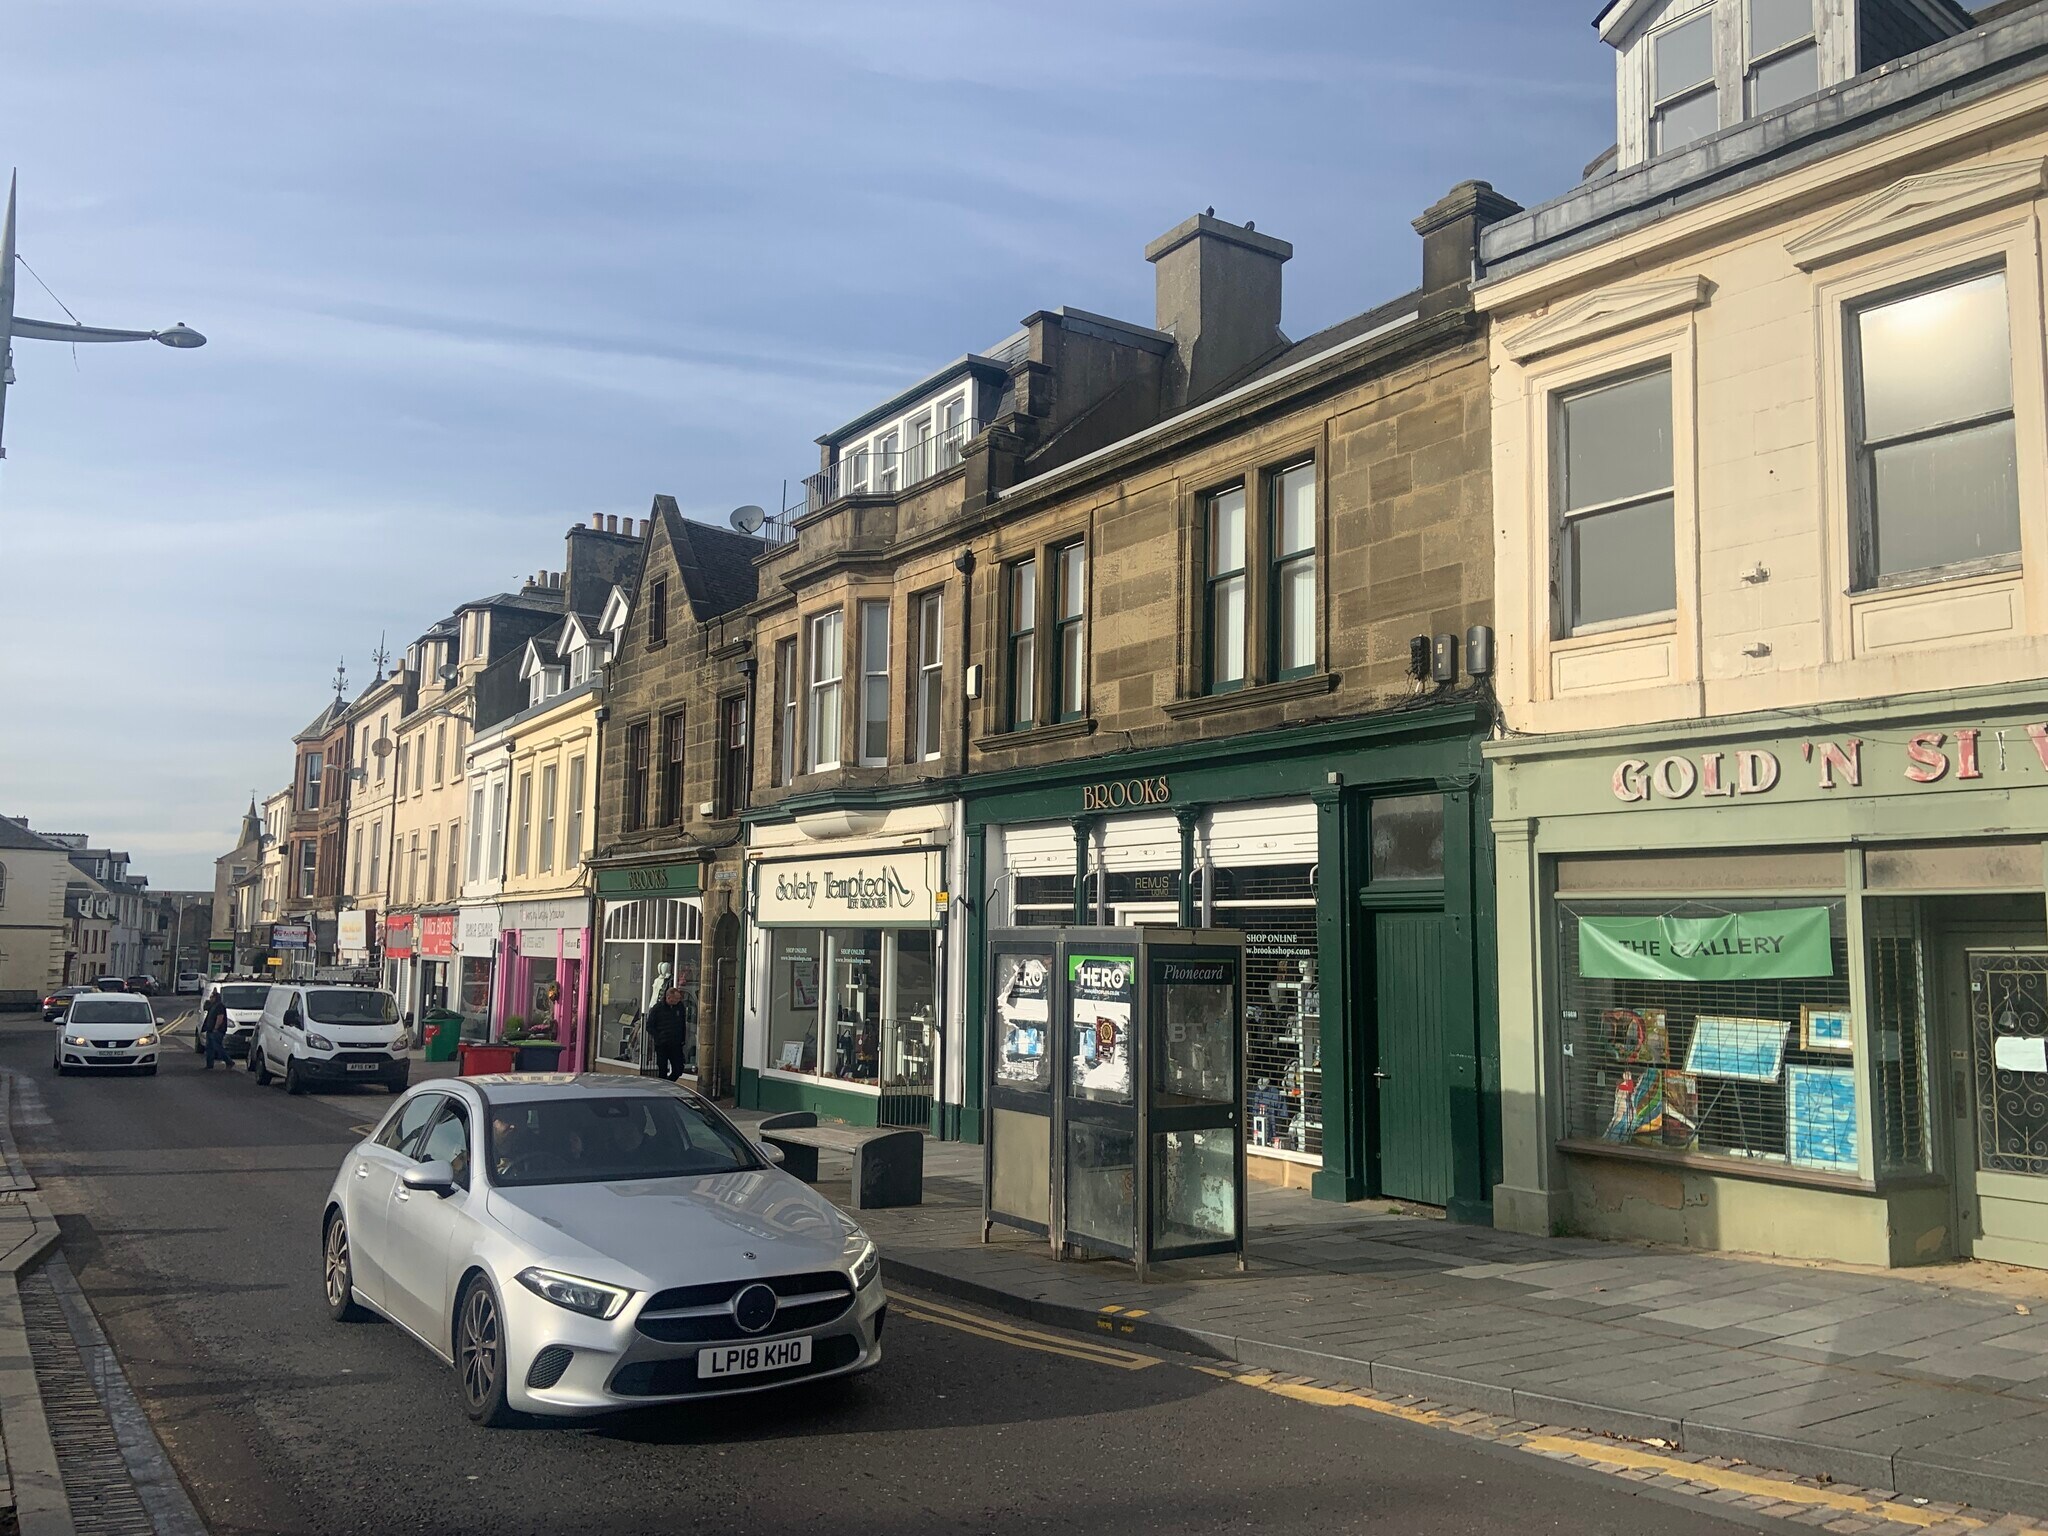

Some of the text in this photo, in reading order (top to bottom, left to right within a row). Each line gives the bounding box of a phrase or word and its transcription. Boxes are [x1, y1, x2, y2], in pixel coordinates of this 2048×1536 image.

[1612, 749, 1782, 802] GOLD
[1083, 775, 1170, 811] BROOKS
[628, 869, 669, 890] BROOKS
[775, 870, 818, 909] Solely
[824, 865, 887, 908] Tempted
[1135, 876, 1169, 889] REMUS
[1246, 934, 1298, 943] SHOP ONLINE
[1619, 940, 1660, 957] THE
[1015, 971, 1043, 987] ERO
[1080, 966, 1124, 989] HERO
[1163, 964, 1224, 980] Phonecard
[712, 1341, 801, 1373] LP18 KHO
